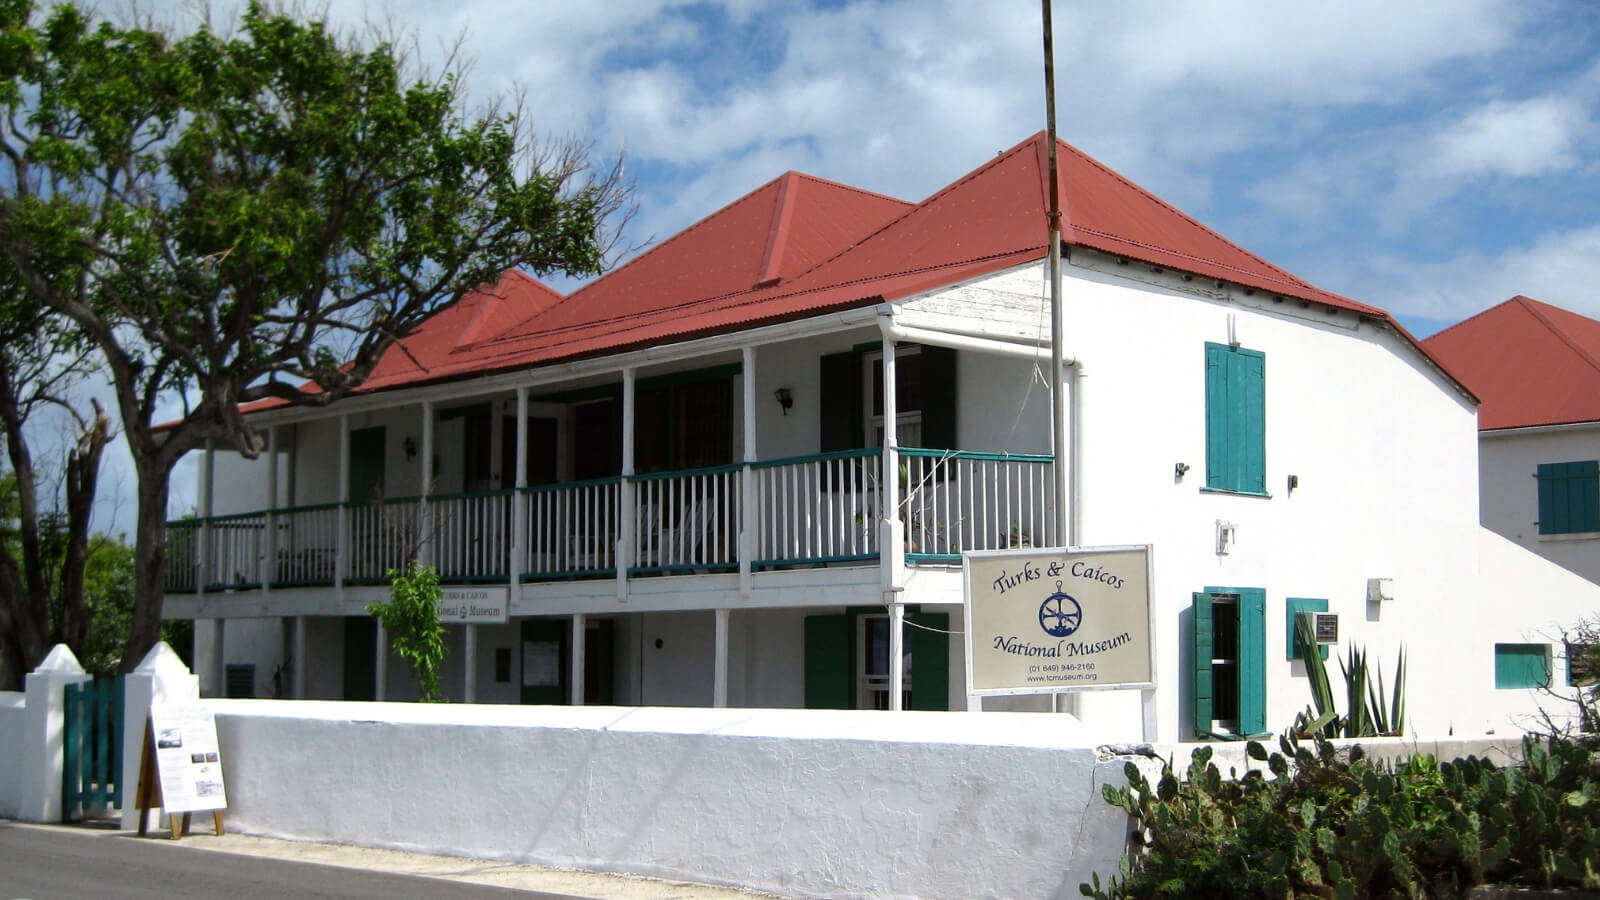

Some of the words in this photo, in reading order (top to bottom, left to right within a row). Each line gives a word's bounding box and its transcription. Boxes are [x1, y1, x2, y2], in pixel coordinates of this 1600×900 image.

[993, 561, 1041, 594] Turks
[1047, 561, 1065, 577] &
[1071, 561, 1125, 589] Caicos
[469, 604, 501, 617] Museum
[993, 635, 1064, 658] National
[1066, 632, 1132, 657] Museum
[1029, 665, 1040, 673] (01
[1042, 664, 1059, 673] 649)
[1061, 663, 1095, 672] 946-2160
[1027, 673, 1097, 682] www.tcmuseum.org
